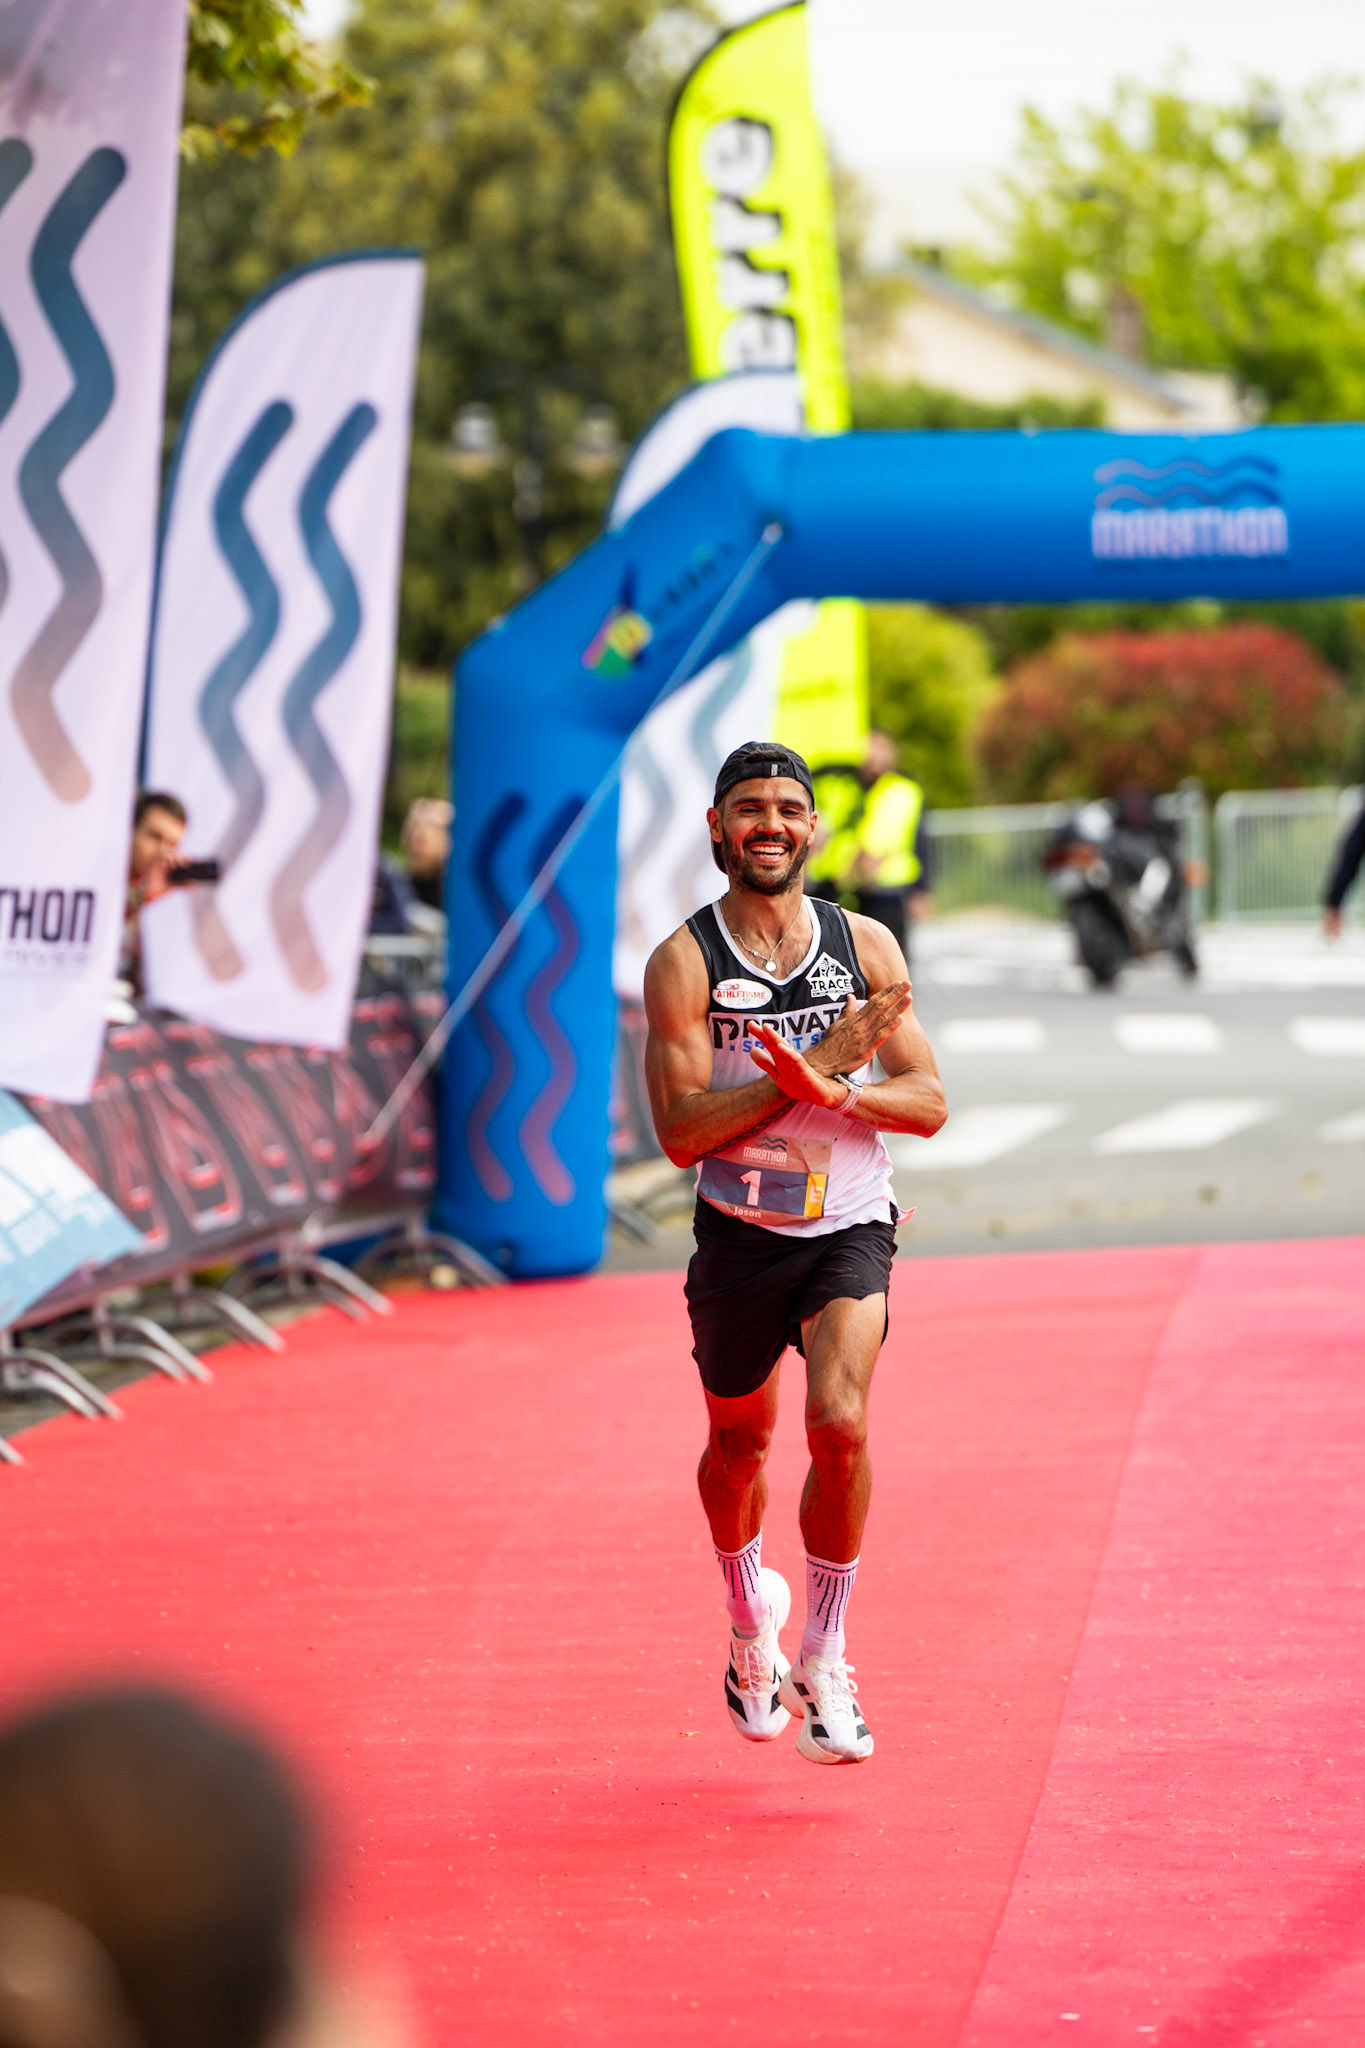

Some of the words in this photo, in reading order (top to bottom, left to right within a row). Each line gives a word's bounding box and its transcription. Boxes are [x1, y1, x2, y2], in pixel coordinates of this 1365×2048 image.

[811, 978, 851, 991] TRACE
[743, 1007, 847, 1039] PRIVAT
[743, 1146, 788, 1163] MARATHON
[740, 1170, 762, 1207] 1
[733, 1206, 762, 1219] Jason
